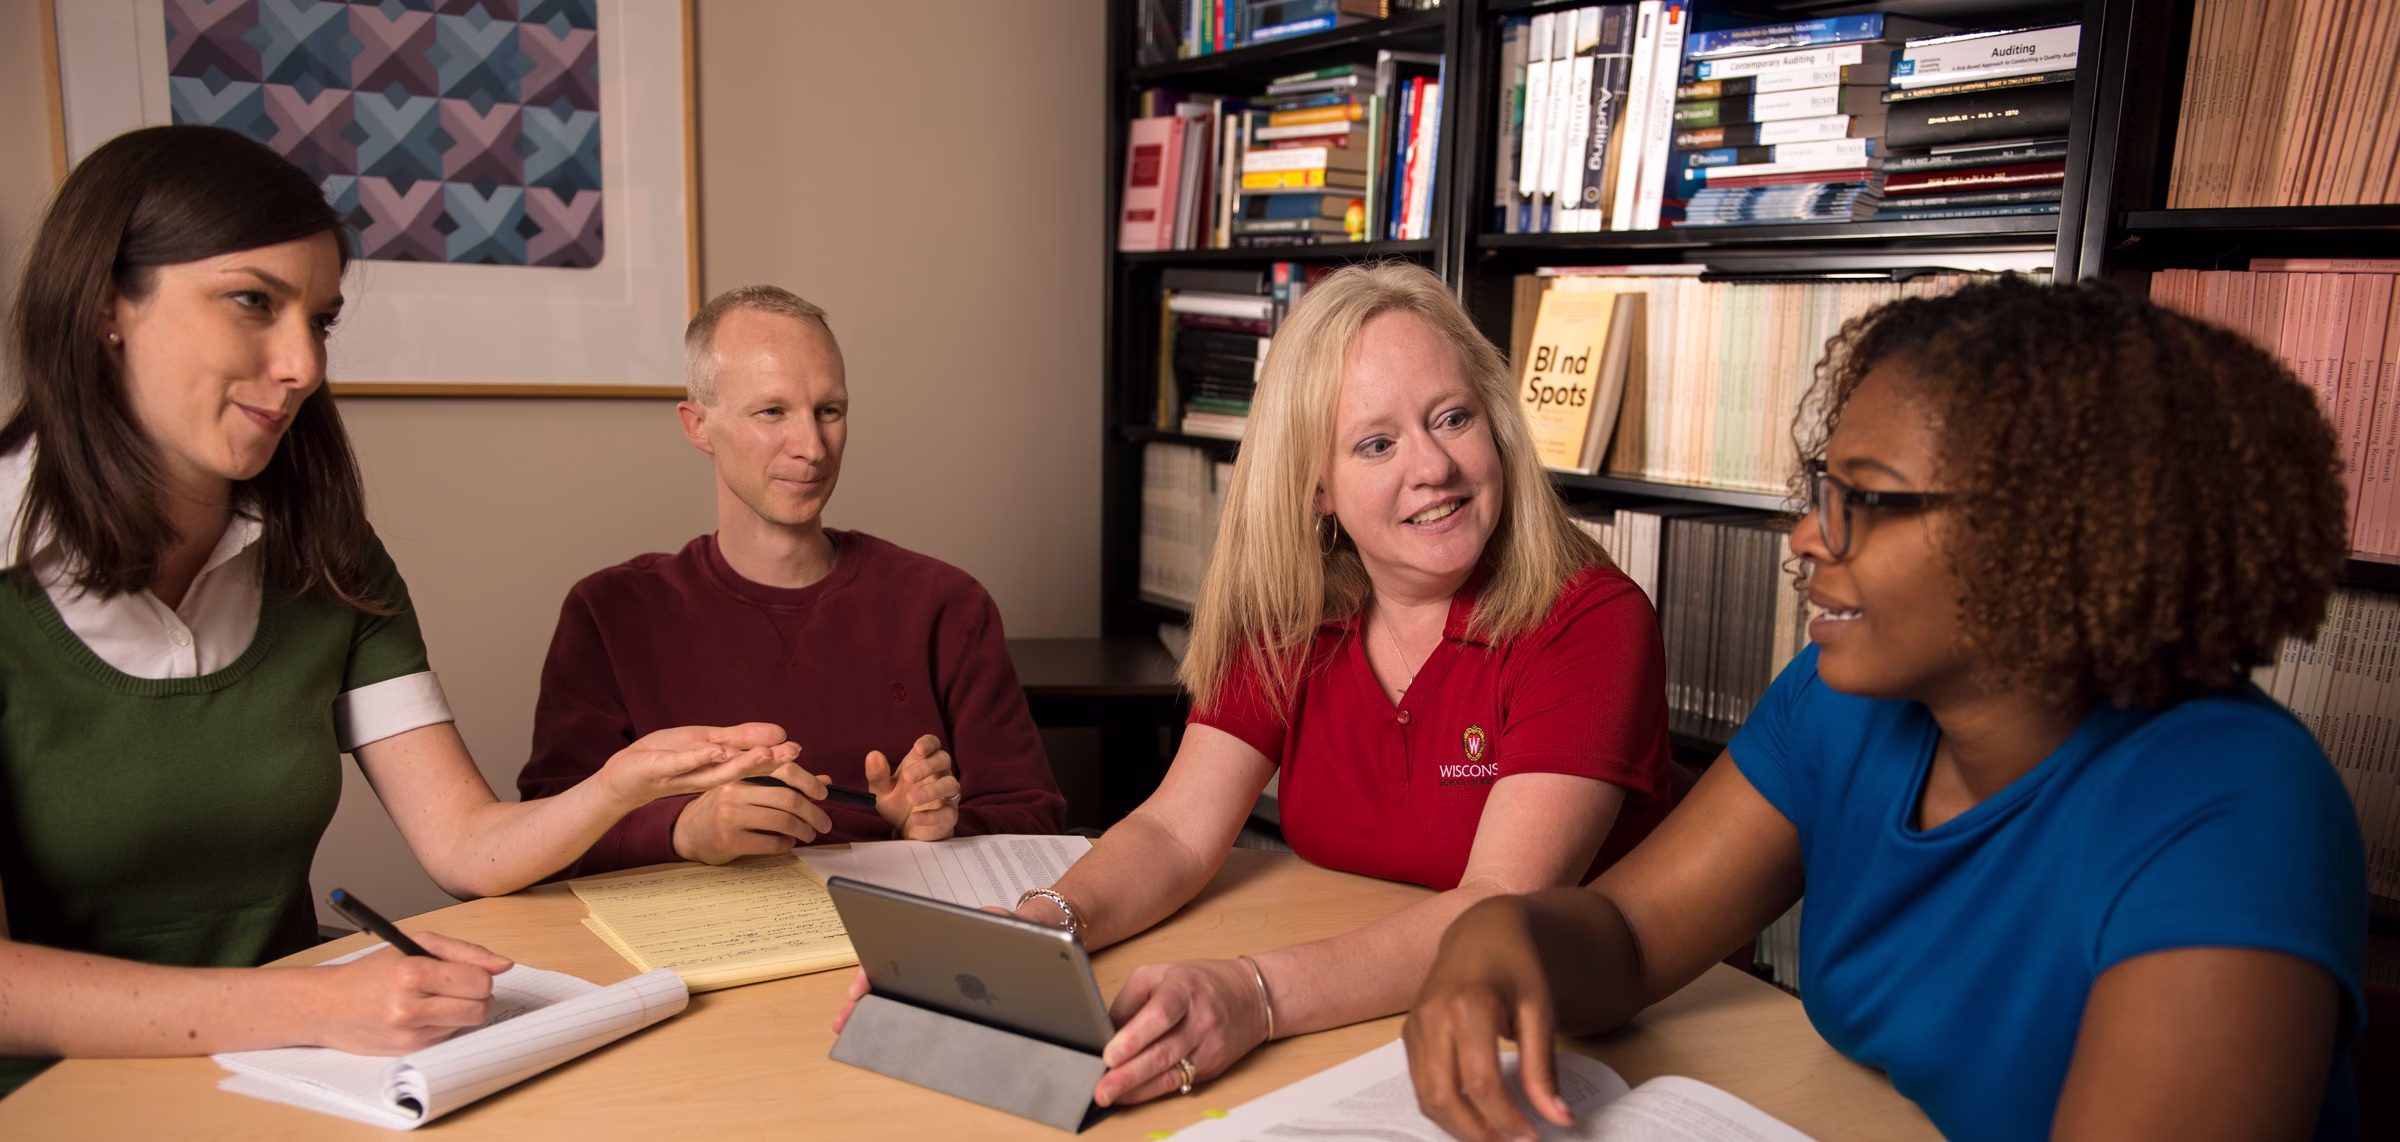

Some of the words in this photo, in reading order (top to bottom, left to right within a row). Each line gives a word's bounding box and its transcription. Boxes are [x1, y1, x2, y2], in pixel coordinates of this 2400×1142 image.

[1730, 59, 1779, 71] Contemporary
[1783, 54, 1815, 66] Auditing
[1981, 60, 2003, 68] Approach
[2010, 55, 2038, 65] Conducting
[2043, 53, 2061, 61] Quality
[1991, 42, 2036, 59] Auditing
[1686, 85, 1713, 96] Auditing
[1588, 87, 1612, 171] Auditing
[1686, 132, 1723, 144] Regulation
[1698, 154, 1728, 164] Business
[2328, 260, 2357, 270] Journal
[2296, 359, 2307, 382] Journ
[2311, 357, 2323, 386] Journal
[2324, 357, 2337, 387] Journal
[2343, 360, 2355, 389] Journal
[2361, 358, 2373, 387] Journal
[2380, 360, 2393, 391] Journal
[1526, 376, 1588, 412] Spots
[2335, 396, 2350, 440] Accounting
[2352, 395, 2368, 439] Accounting
[2371, 399, 2387, 445] Accounting
[2386, 400, 2400, 445] Accounting
[2349, 441, 2360, 474] Research
[2367, 447, 2379, 482] Research
[2382, 448, 2395, 483] Research
[2365, 608, 2373, 628] VOLUME
[2386, 610, 2394, 630] VOLUME
[2320, 631, 2328, 652] Number
[2330, 633, 2338, 653] Number
[2338, 635, 2347, 659] NUMBER
[2347, 637, 2357, 661] NUMBER
[2357, 642, 2365, 663] NUMBER
[2368, 644, 2376, 665] NUMBER
[2378, 644, 2386, 665] NUMBER
[2388, 646, 2397, 666] NUMBER
[2374, 666, 2382, 681] THREE
[2328, 717, 2339, 751] ACCOUNTING
[2340, 712, 2350, 741] ACCOUNTING
[2350, 714, 2360, 743] ACCOUNTING
[2360, 714, 2370, 744] ACCOUNTING
[2371, 716, 2381, 746] ACCOUNTING
[2381, 718, 2392, 749] ACCOUNTING
[1468, 736, 1480, 754] W
[2335, 742, 2343, 766] HORIZONS
[2345, 744, 2354, 768] HORIZONS
[2355, 745, 2364, 769] HORIZONS
[1439, 763, 1498, 777] WISCONS
[2365, 747, 2374, 771] HORIZONS
